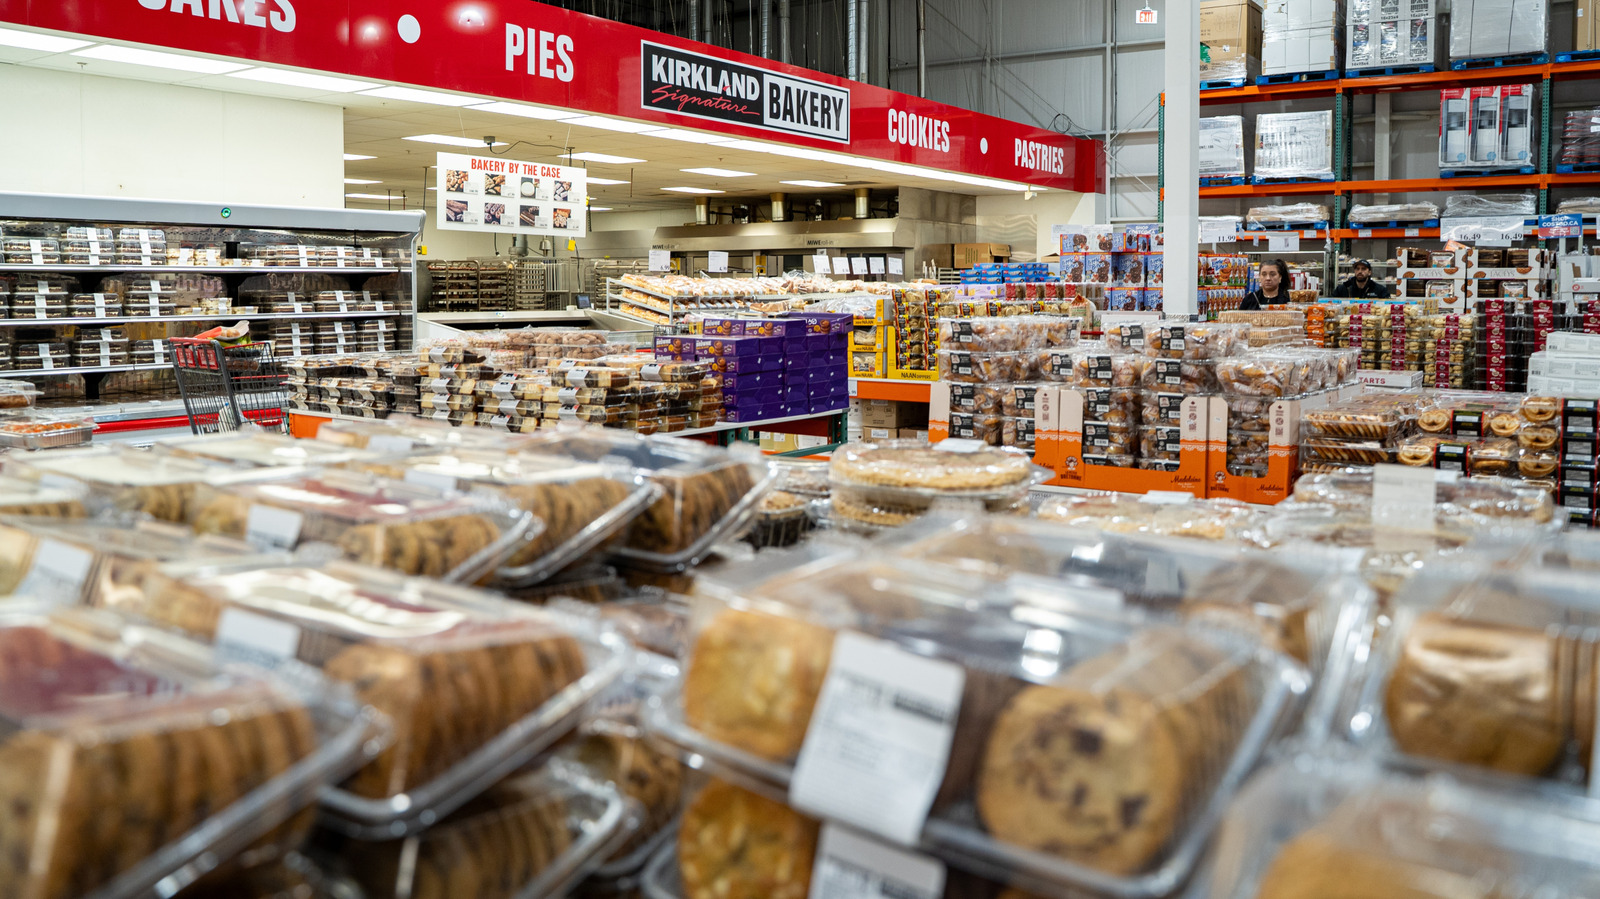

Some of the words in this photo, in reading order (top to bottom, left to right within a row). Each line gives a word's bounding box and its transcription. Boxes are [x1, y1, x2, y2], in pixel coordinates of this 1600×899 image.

[1139, 11, 1154, 23] EXIT
[505, 22, 574, 83] PIES
[652, 54, 760, 102] KIRKLAND
[652, 84, 760, 116] Signature
[768, 82, 844, 132] BAKERY
[888, 108, 950, 153] COOKIES
[471, 158, 506, 172] BAKERY
[508, 162, 519, 174] BY
[522, 164, 538, 176] THE
[540, 166, 561, 178] CASE
[1014, 138, 1064, 175] PASTRIES
